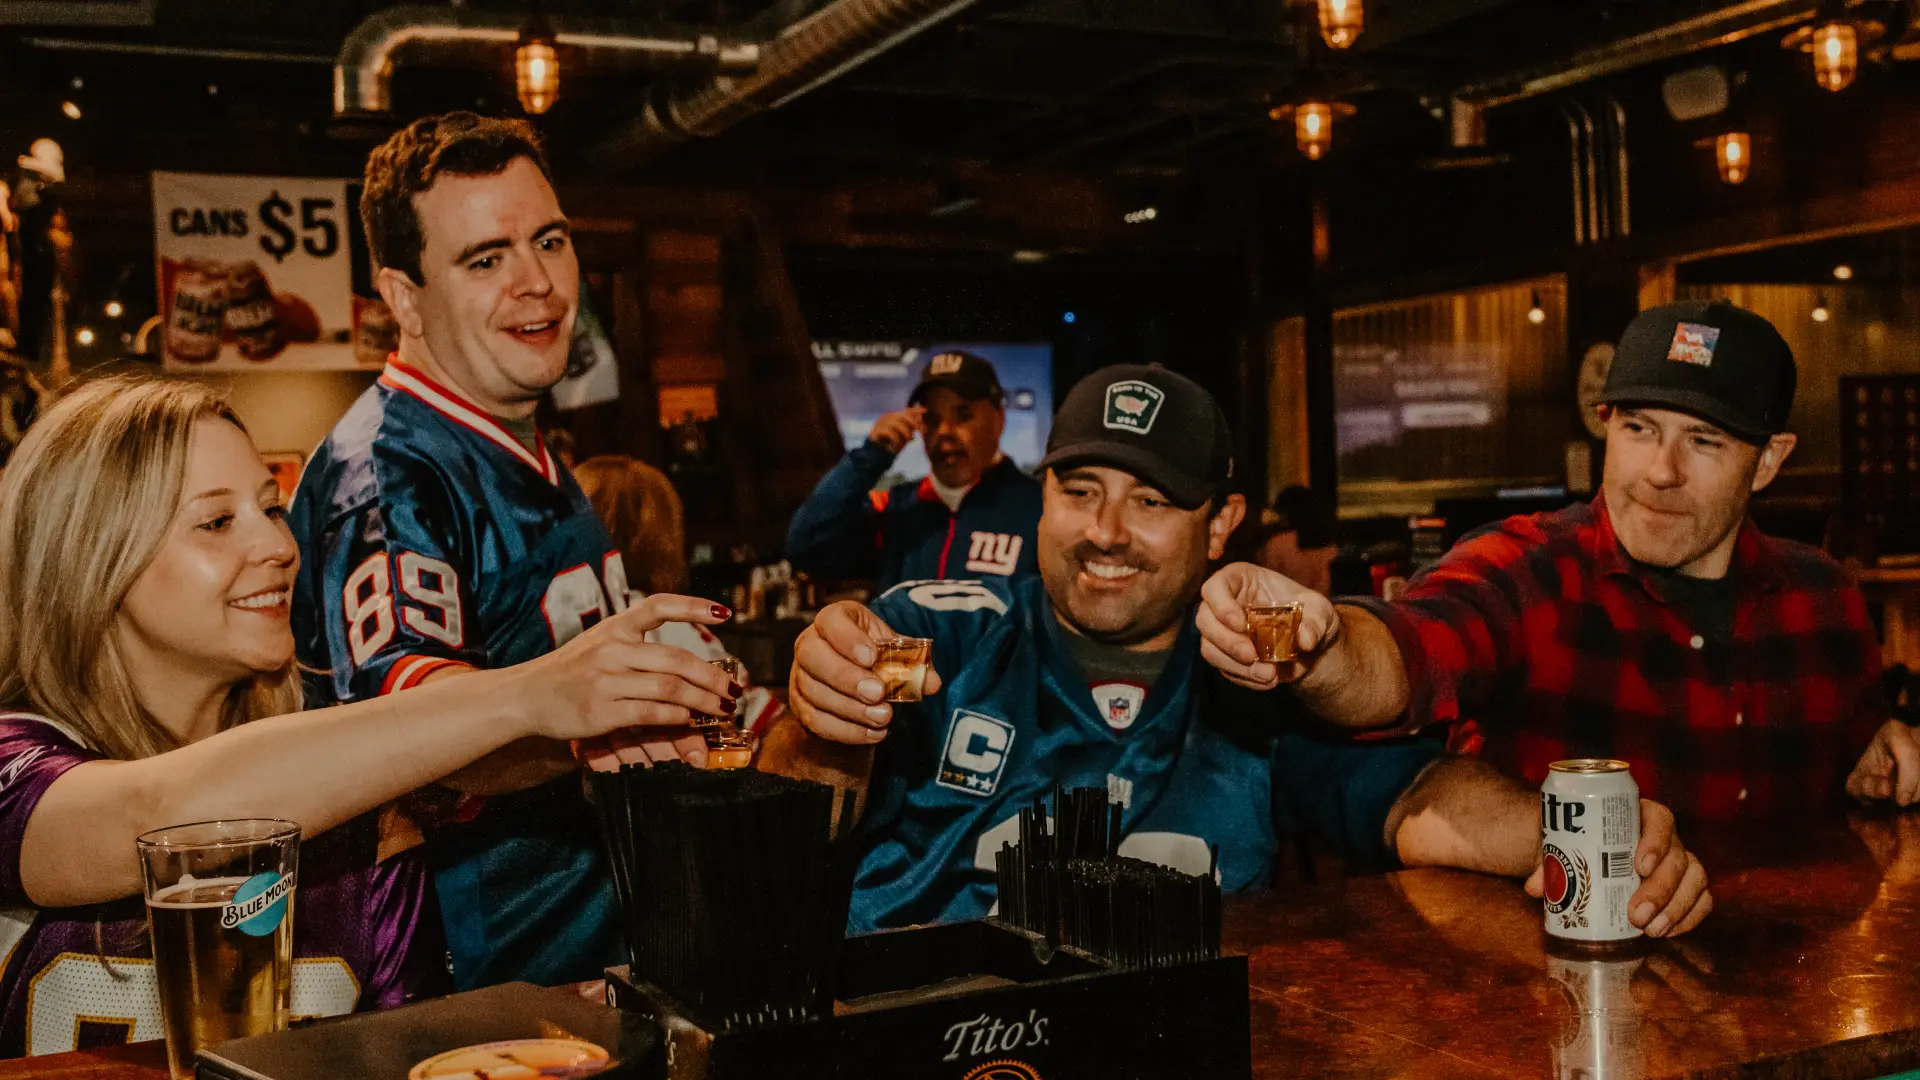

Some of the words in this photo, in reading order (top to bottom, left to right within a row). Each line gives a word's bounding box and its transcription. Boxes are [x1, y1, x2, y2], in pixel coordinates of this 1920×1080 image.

[170, 207, 248, 237] CANS
[258, 190, 339, 264] $5
[342, 550, 465, 668] 89
[947, 714, 1010, 774] C
[1549, 845, 1574, 878] PILSNER
[223, 896, 263, 926] BLUE
[265, 876, 294, 905] MOON
